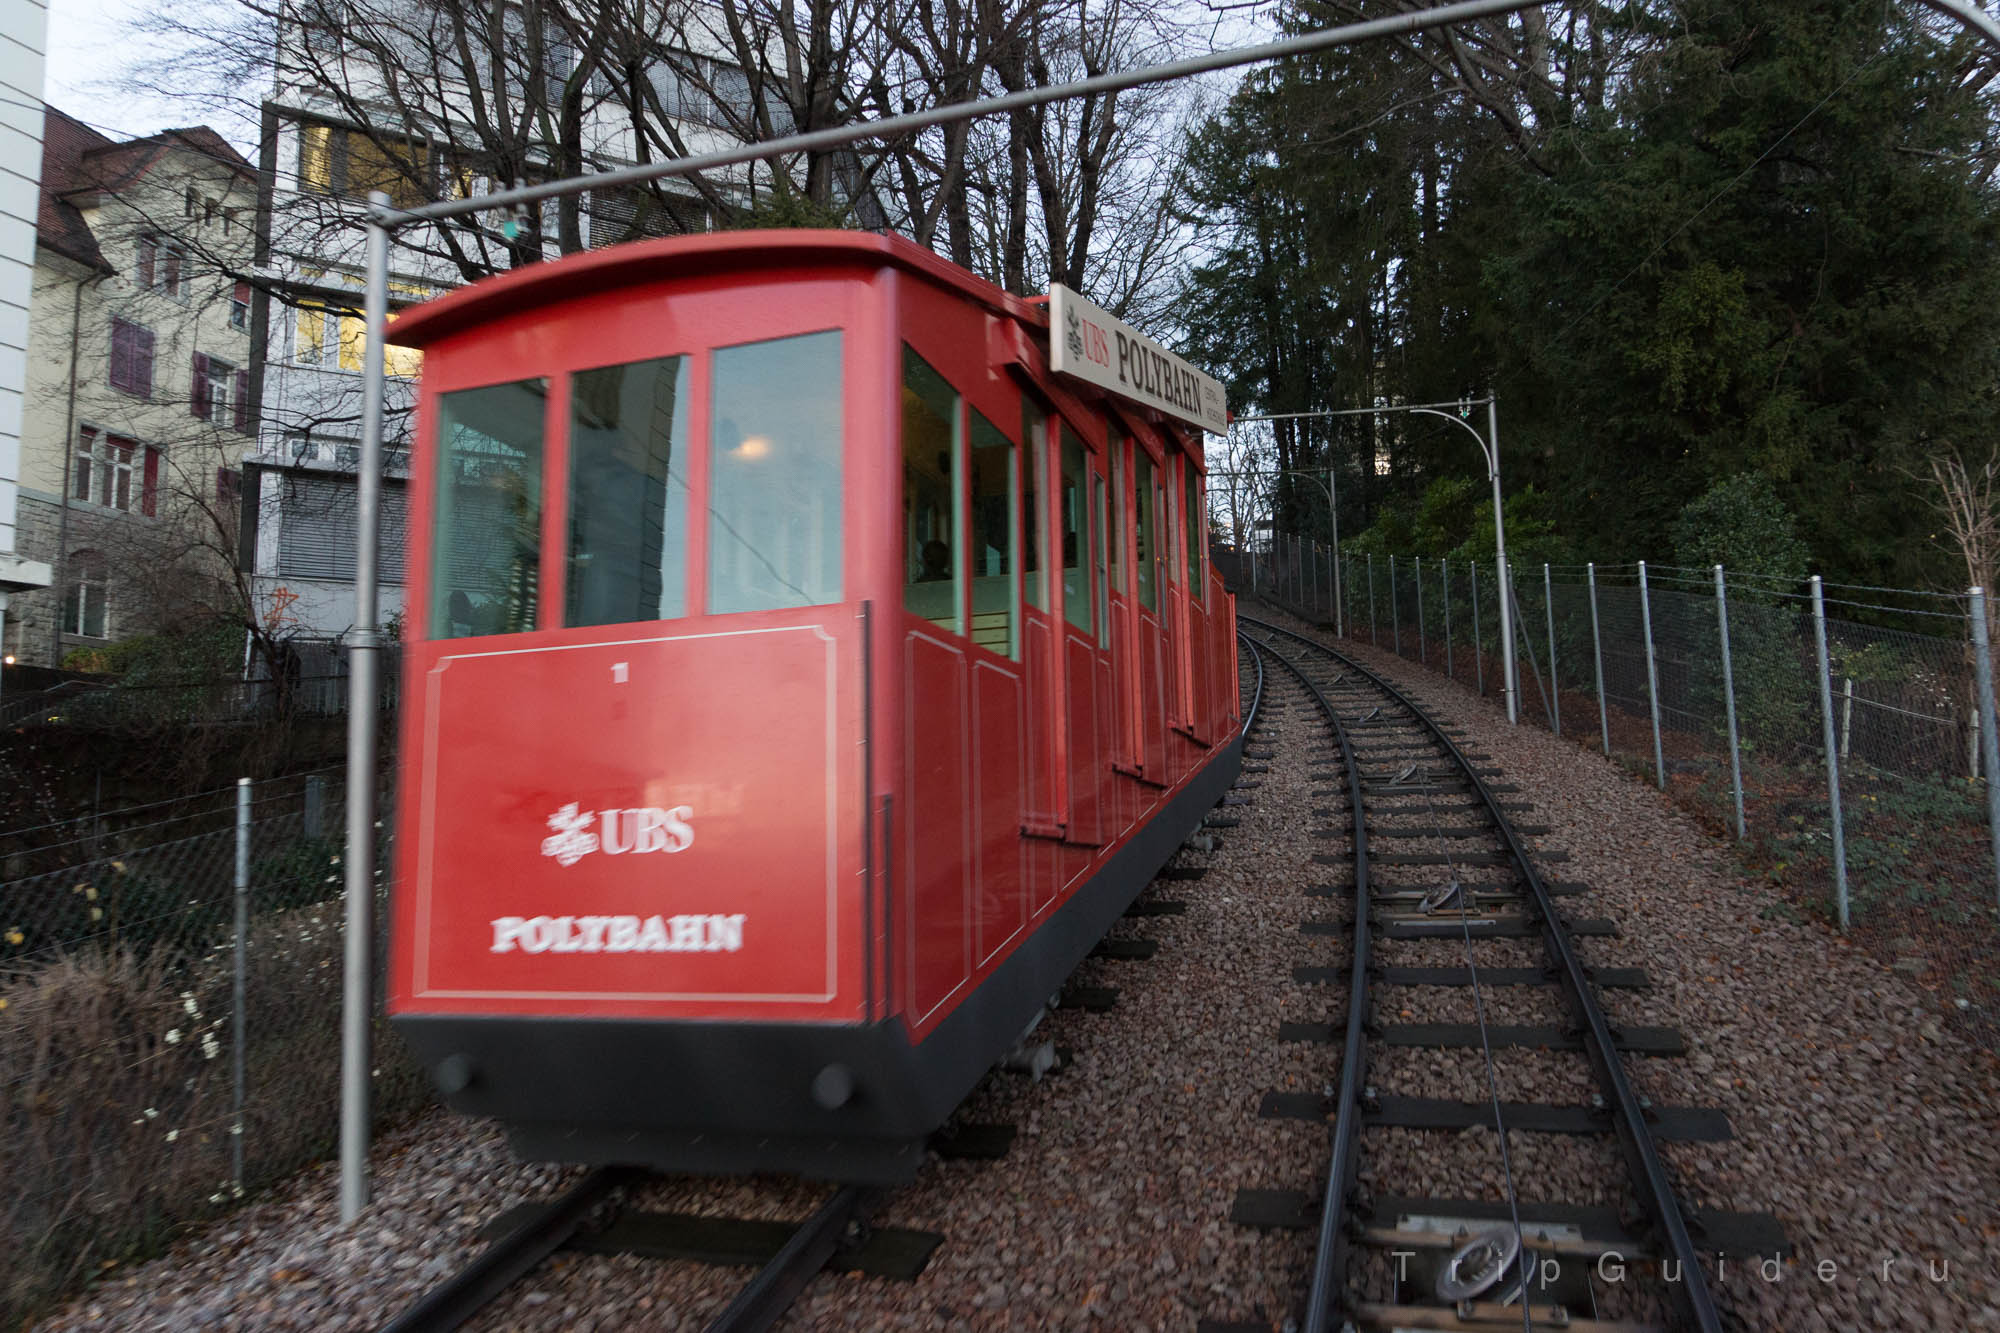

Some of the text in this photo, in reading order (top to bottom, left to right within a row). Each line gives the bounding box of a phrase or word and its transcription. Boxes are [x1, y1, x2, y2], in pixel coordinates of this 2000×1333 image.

[1082, 318, 1202, 417] UBS POLYBAHN
[611, 662, 629, 683] 1
[599, 805, 695, 855] UBS
[490, 913, 748, 953] POLYBAHN
